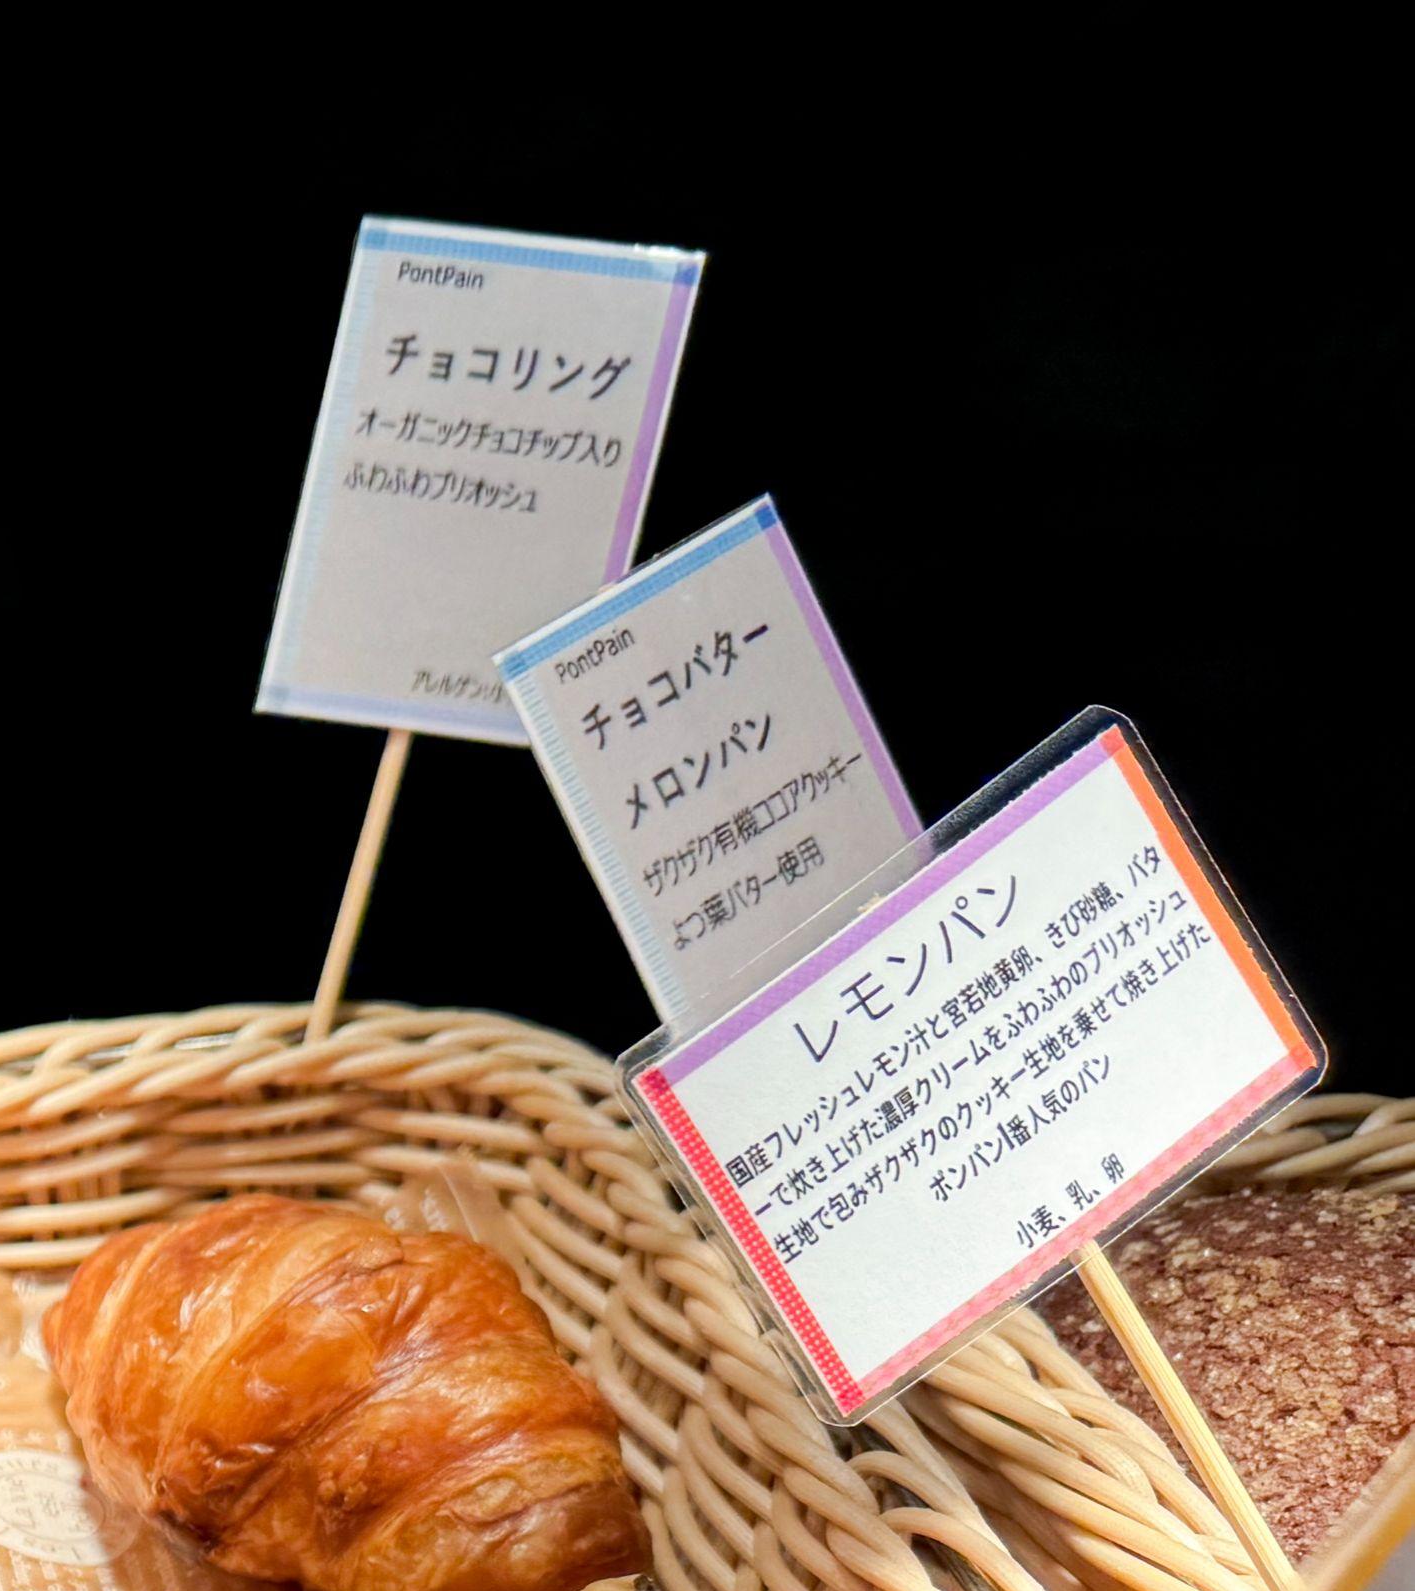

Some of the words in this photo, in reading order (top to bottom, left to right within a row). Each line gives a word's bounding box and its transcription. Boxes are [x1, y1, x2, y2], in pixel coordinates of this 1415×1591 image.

[398, 262, 485, 291] PontPain
[386, 333, 632, 401] チョコリング
[343, 461, 538, 513] ふわふわブリオッシュ
[355, 407, 622, 468] オーガニックチョコチップ入り
[556, 628, 635, 684] PontPain
[581, 623, 769, 751] チョコバター
[625, 712, 773, 830] メロンパン
[642, 750, 863, 898] ザクザク有機ココアクッキー
[673, 835, 825, 952] よつ葉バター使用
[794, 874, 1022, 1064] レモンパン
[775, 918, 1213, 1265] 生地で包みザクザクのクッキー生地を乗せて焼き上げた
[1015, 1151, 1127, 1252] 小麦、乳、卵
